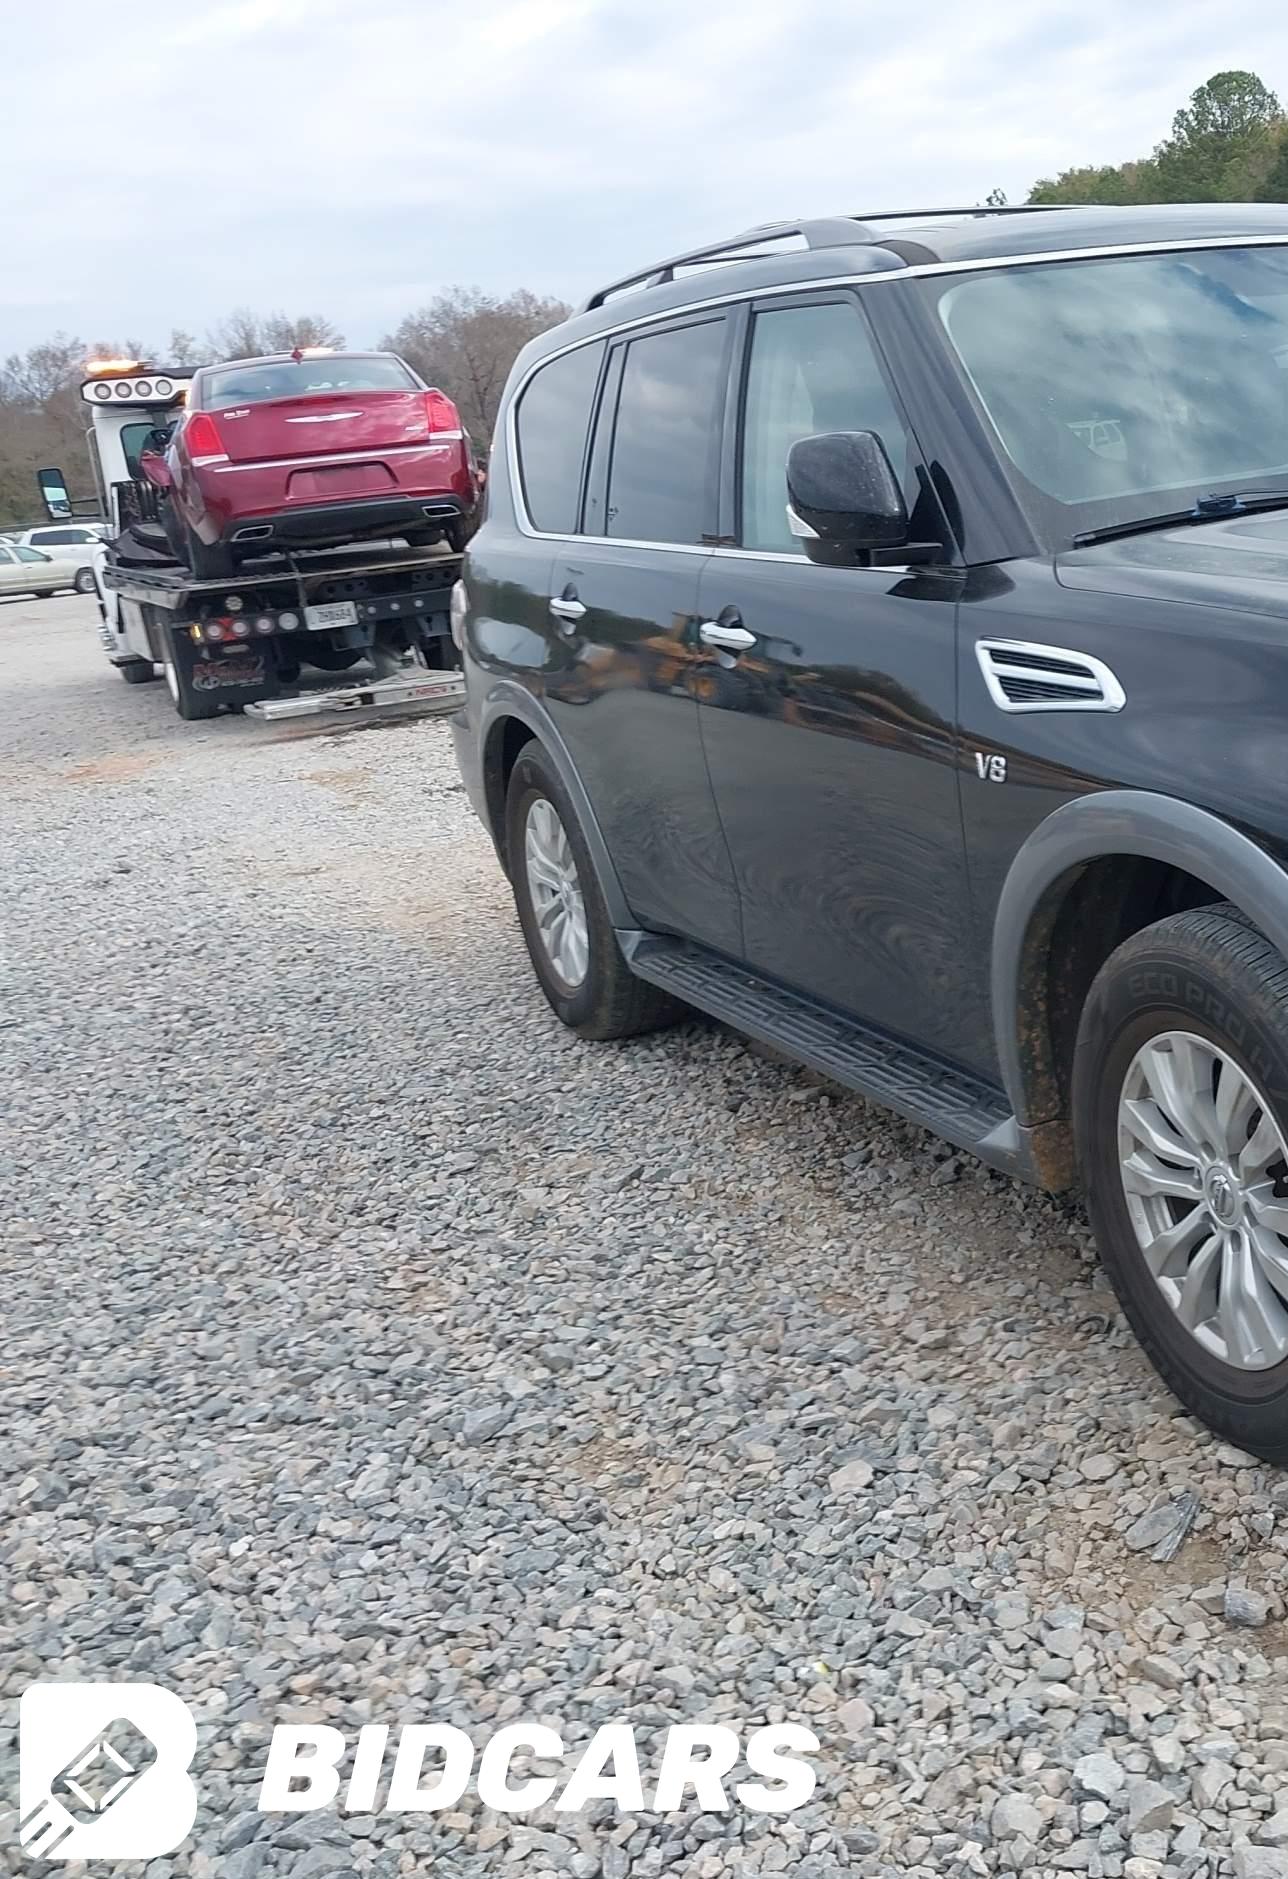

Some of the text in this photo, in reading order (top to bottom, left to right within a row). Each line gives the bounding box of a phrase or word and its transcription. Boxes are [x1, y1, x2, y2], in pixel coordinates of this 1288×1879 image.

[975, 752, 1007, 783] V8
[1128, 971, 1178, 999] ECO
[1185, 981, 1245, 1045] PRO
